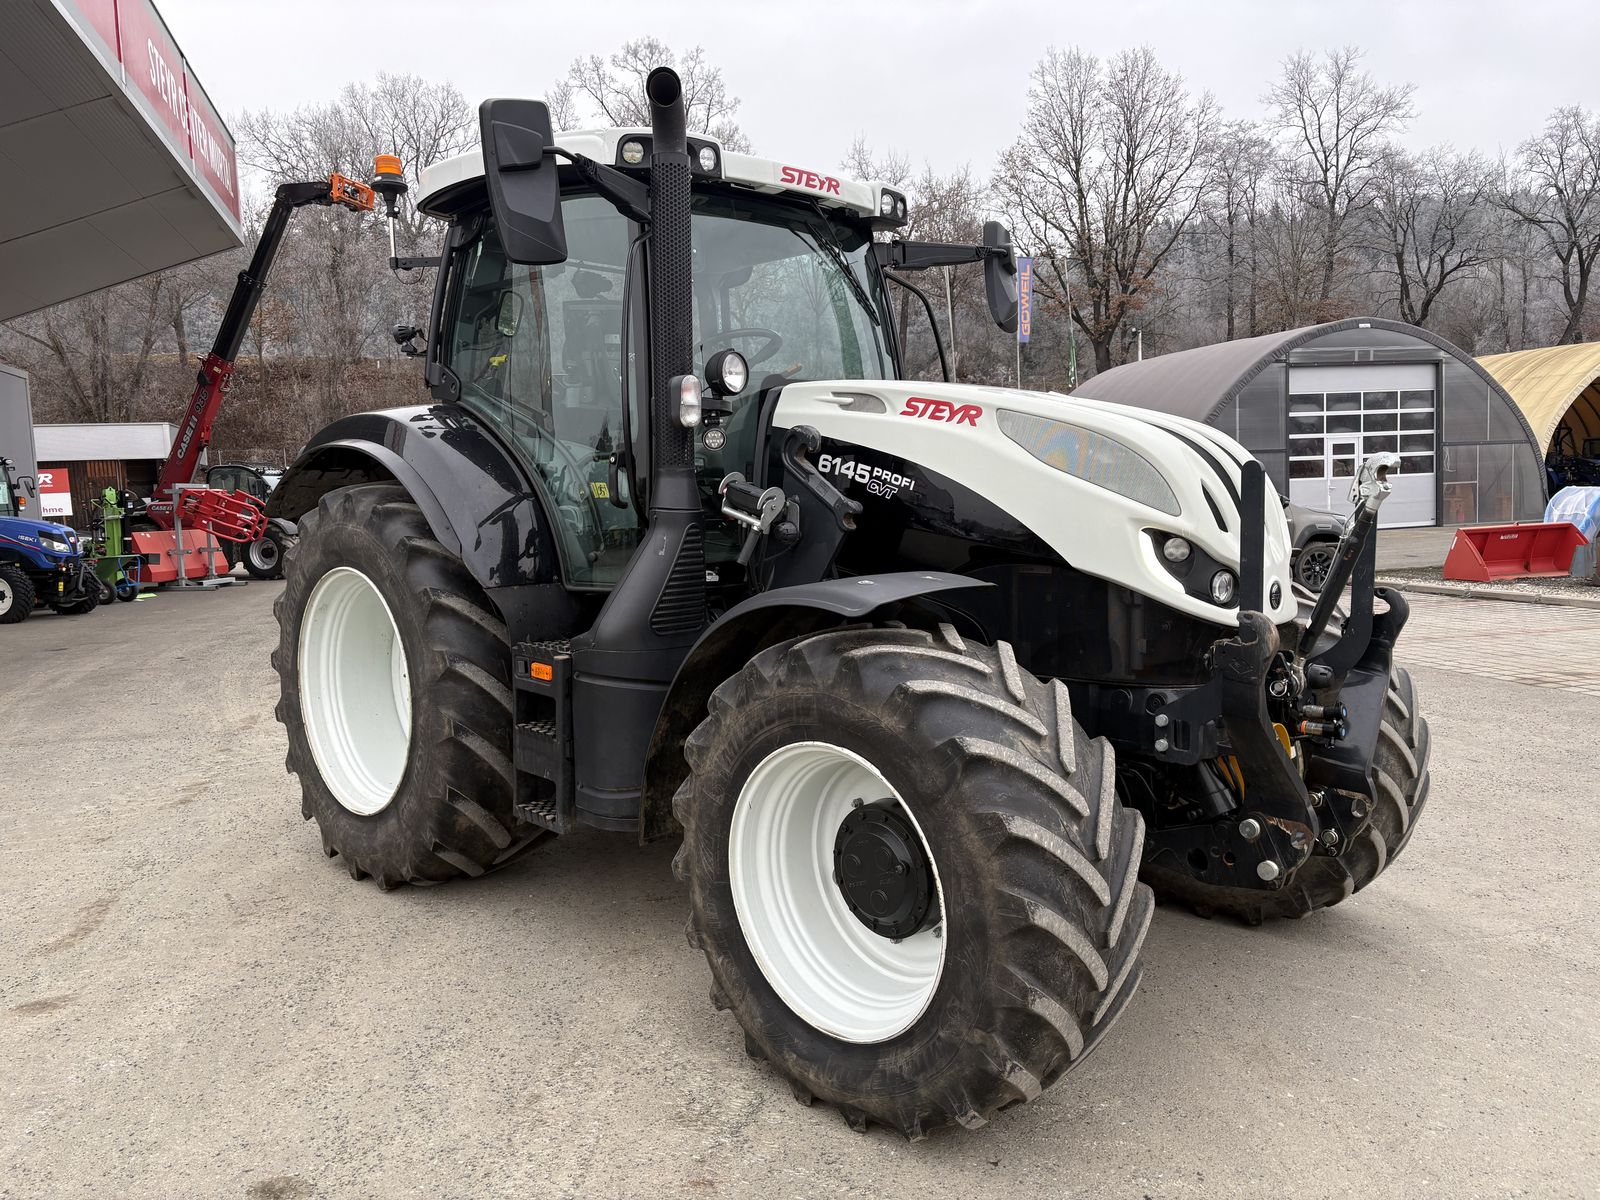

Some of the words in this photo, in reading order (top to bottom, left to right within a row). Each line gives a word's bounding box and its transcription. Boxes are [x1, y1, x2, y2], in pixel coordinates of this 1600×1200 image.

[147, 37, 180, 121] STEYR
[178, 85, 210, 164] CENTER
[780, 165, 840, 196] STEYR
[899, 396, 983, 427] STEYR
[177, 425, 194, 459] CASE
[38, 473, 53, 484] R
[817, 454, 872, 484] 6145
[872, 467, 916, 491] PROFI
[866, 479, 898, 499] CVT
[17, 534, 38, 543] ISEKI
